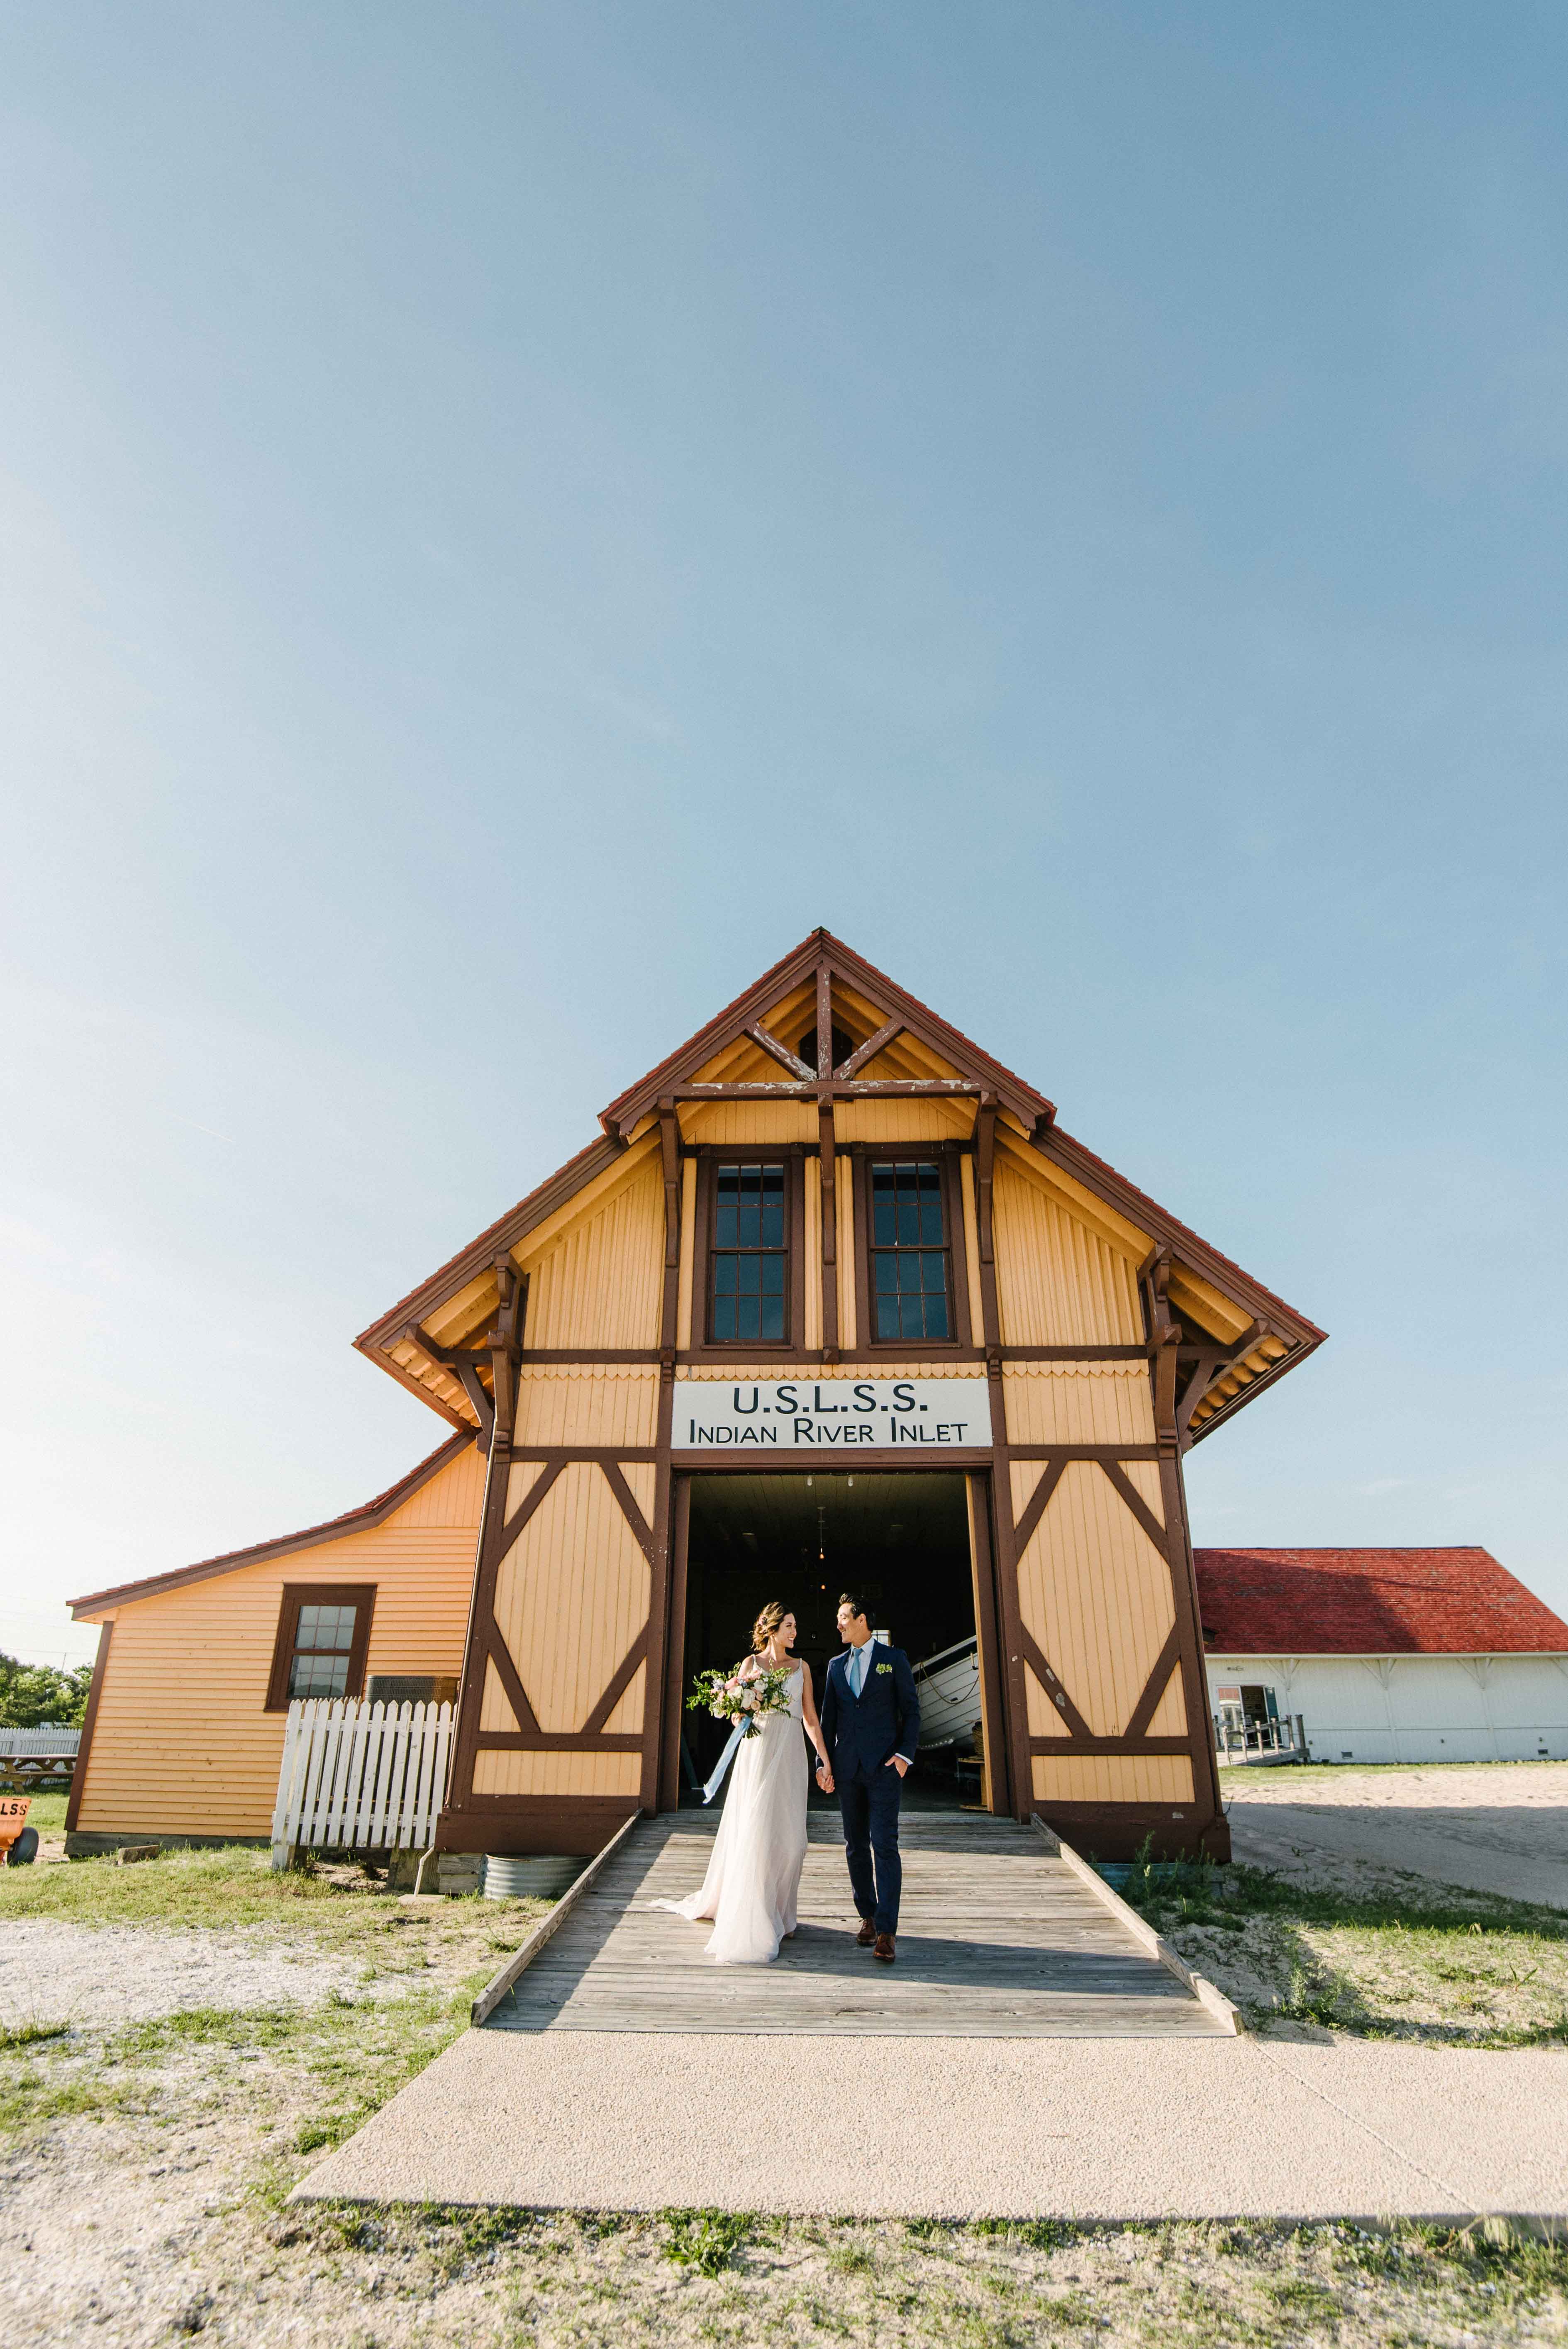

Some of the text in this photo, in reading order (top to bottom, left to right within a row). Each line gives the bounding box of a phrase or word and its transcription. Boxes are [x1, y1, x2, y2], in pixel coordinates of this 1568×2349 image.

[734, 1383, 928, 1415] U.S.L.S.S.
[690, 1417, 968, 1443] INDIAN RIVER INLET
